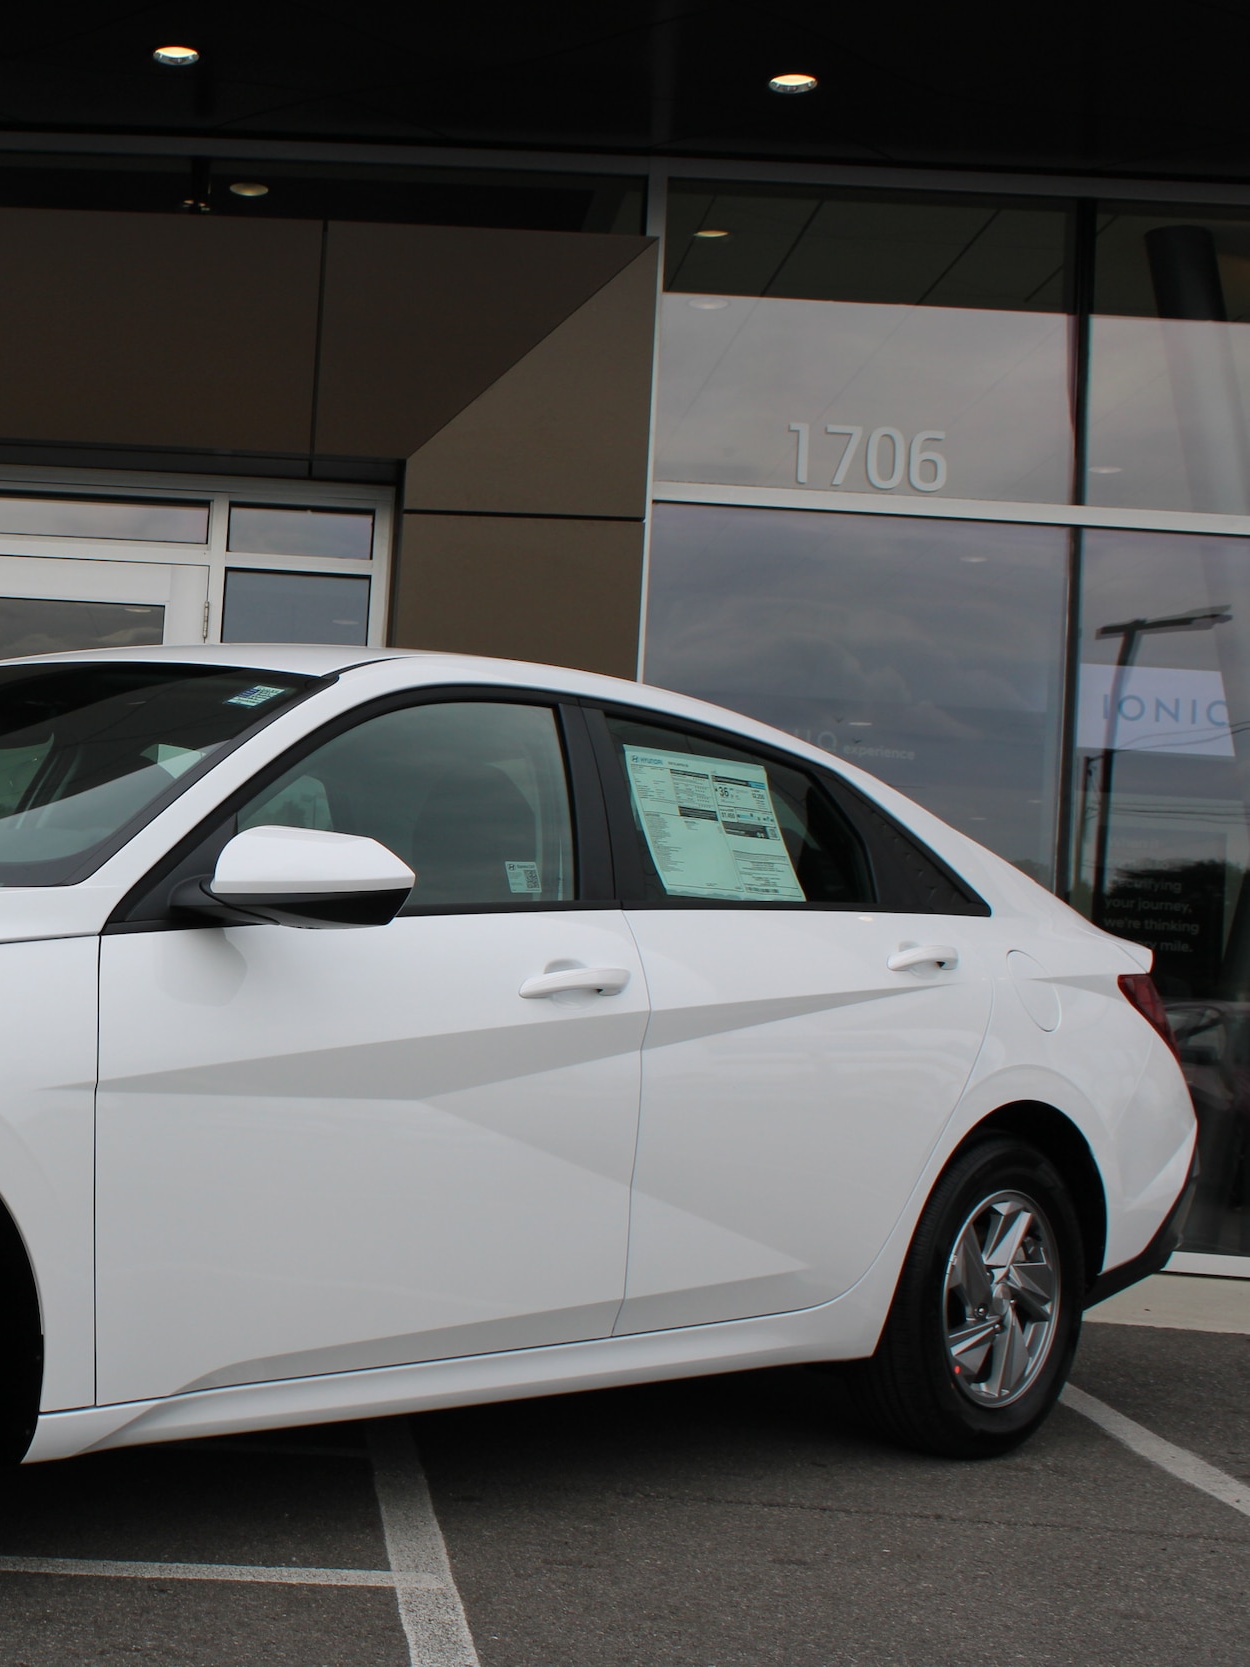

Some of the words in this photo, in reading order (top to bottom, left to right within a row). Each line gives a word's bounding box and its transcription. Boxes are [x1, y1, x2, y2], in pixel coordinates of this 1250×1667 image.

[787, 422, 948, 494] 1706
[843, 745, 916, 761] experience
[718, 785, 730, 798] 36
[1144, 918, 1200, 935] thinking
